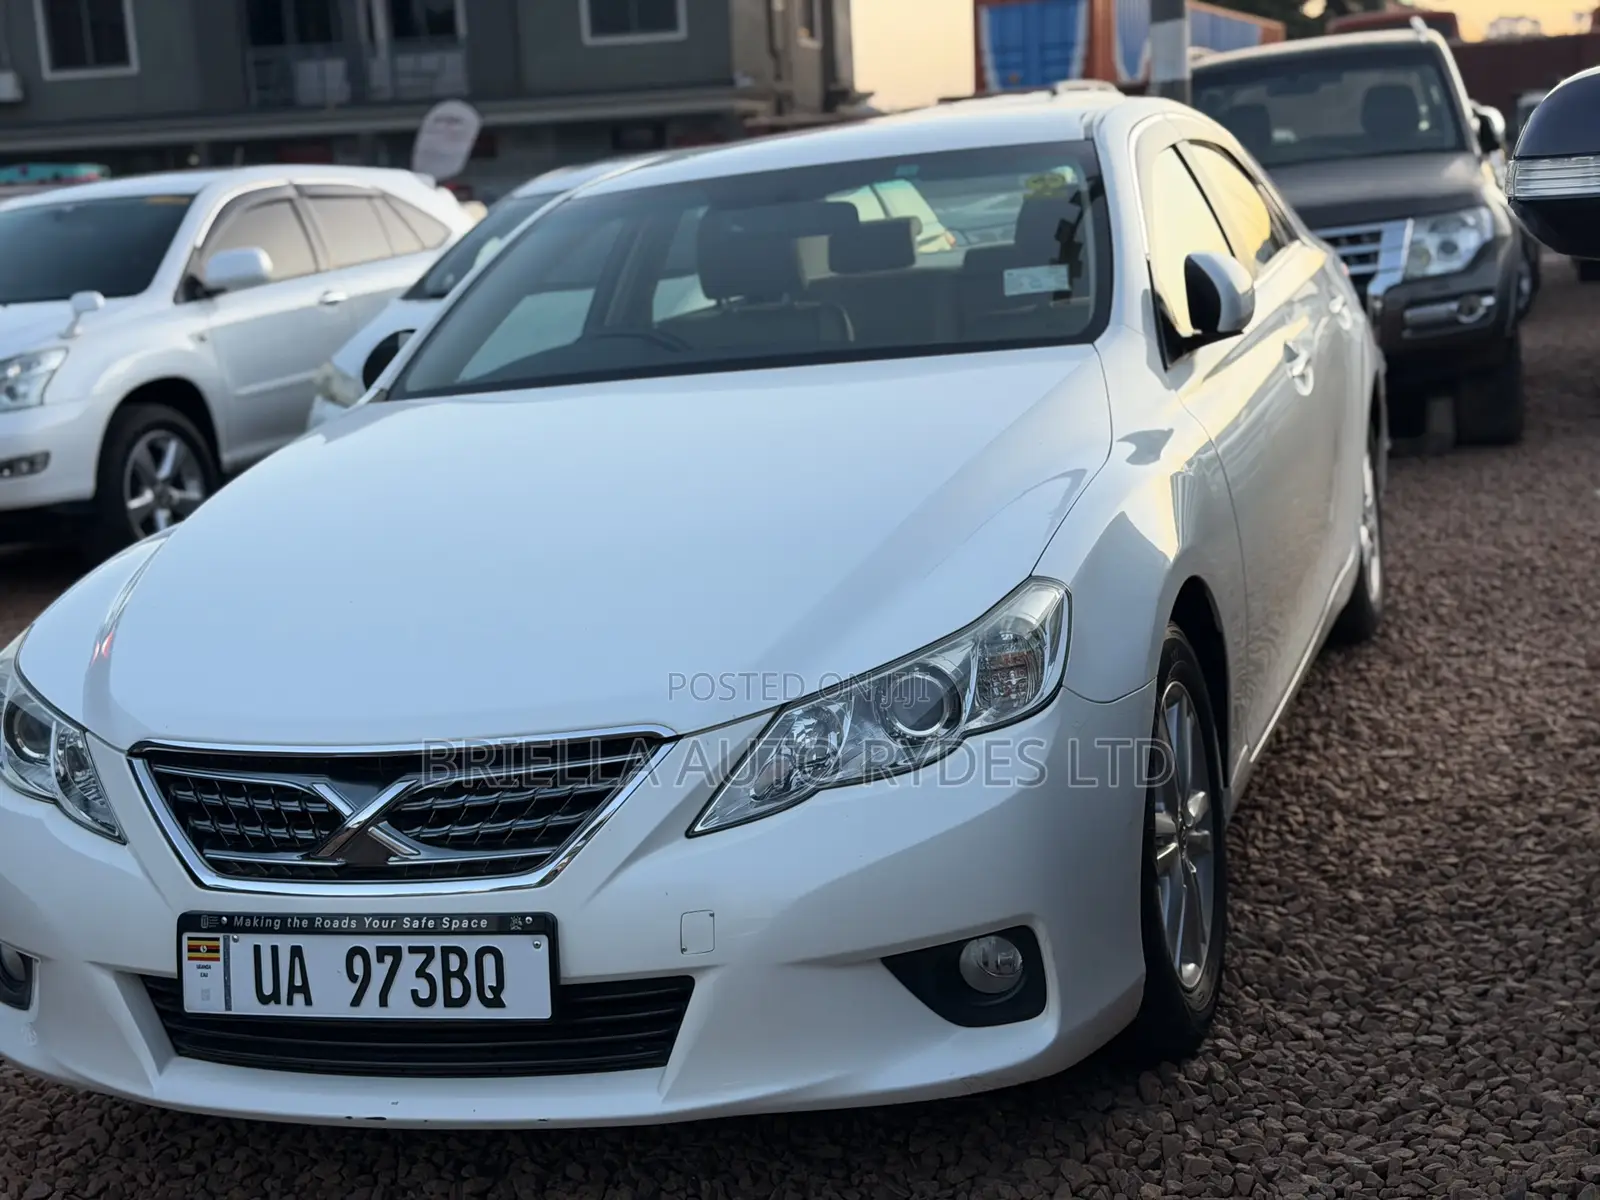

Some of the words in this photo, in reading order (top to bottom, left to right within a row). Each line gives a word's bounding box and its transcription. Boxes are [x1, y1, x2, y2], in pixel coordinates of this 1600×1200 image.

[233, 916, 281, 930] Making
[287, 916, 308, 929] the
[314, 916, 357, 929] Roads
[364, 916, 396, 929] Your
[402, 916, 435, 929] Safe
[441, 916, 488, 931] Space
[252, 943, 313, 1007] UA
[345, 944, 507, 1009] 973BQ
